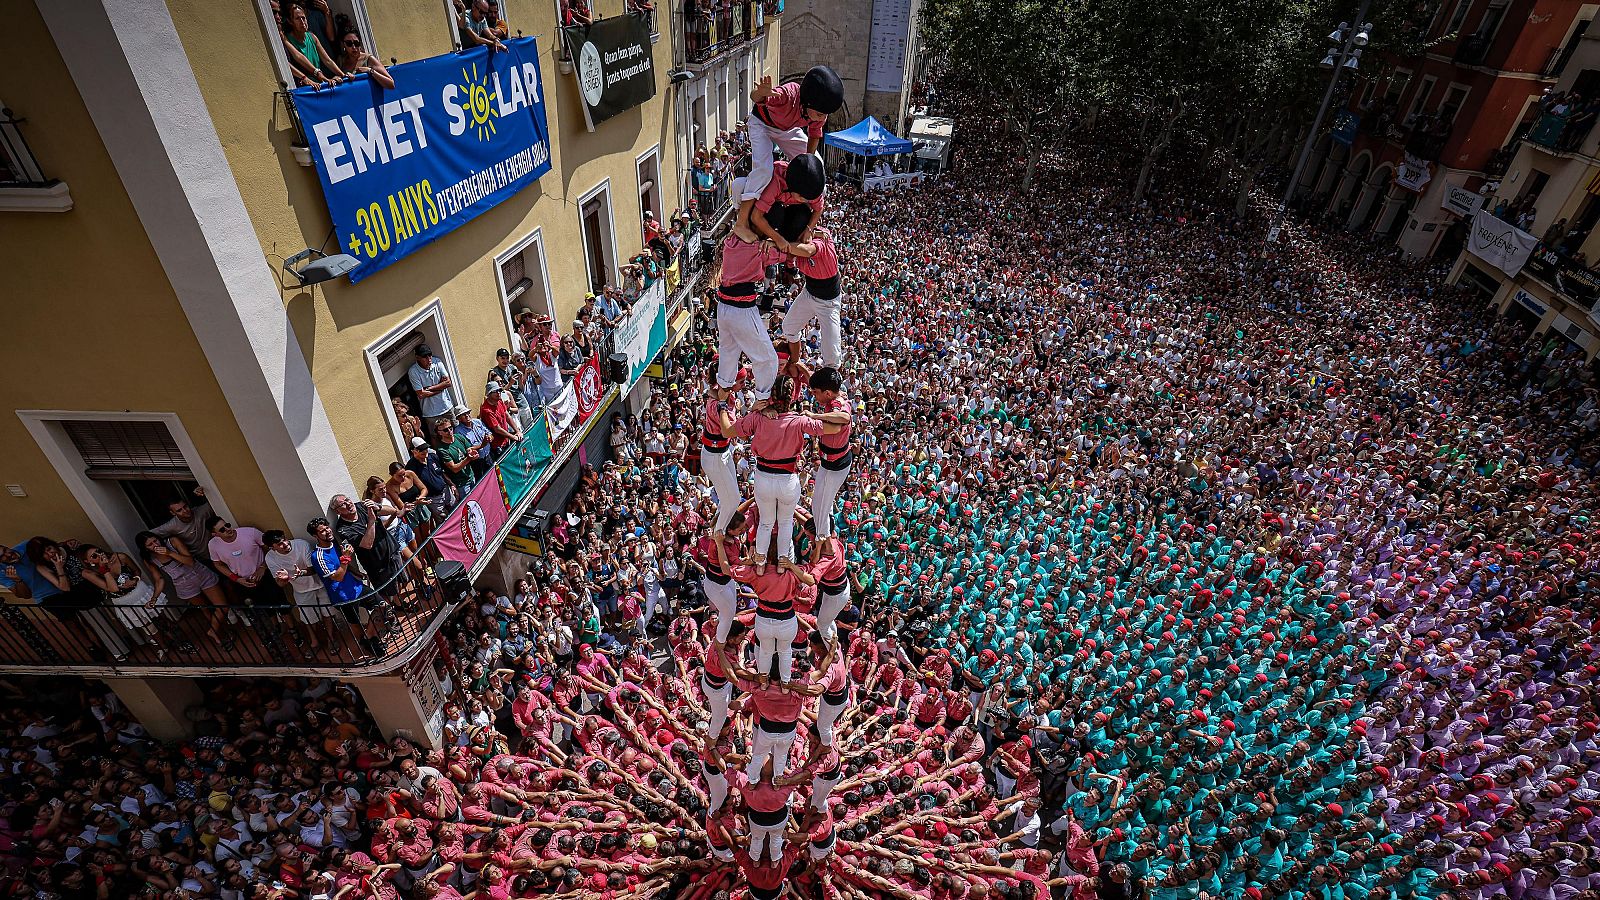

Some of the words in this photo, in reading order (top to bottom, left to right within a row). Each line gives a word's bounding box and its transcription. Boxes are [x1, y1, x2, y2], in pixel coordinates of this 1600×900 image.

[312, 93, 428, 185] EMET
[442, 62, 540, 138] SOLAR
[348, 201, 391, 259] +30
[387, 178, 439, 244] ANYS
[435, 166, 498, 221] D'EXPERIÈNCIA
[494, 163, 508, 189] EN
[504, 148, 534, 184] ENERGIA
[1477, 227, 1519, 256] FREIXENET
